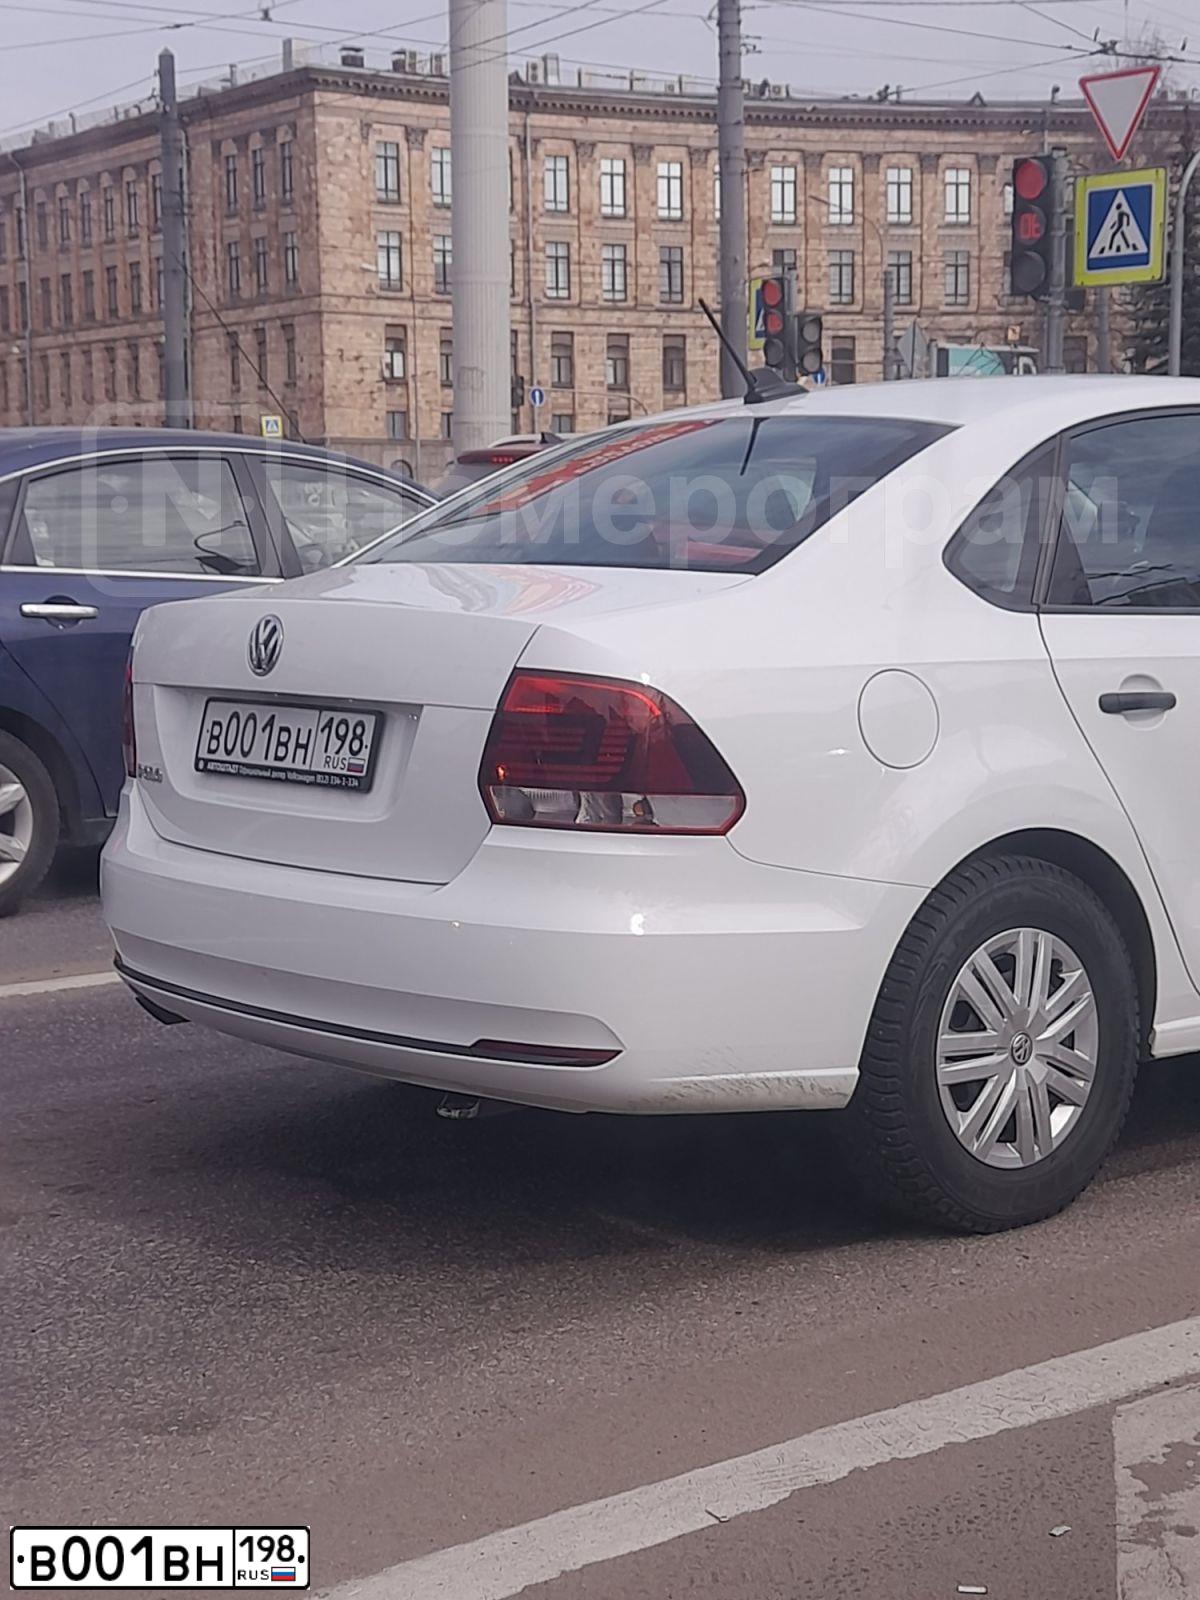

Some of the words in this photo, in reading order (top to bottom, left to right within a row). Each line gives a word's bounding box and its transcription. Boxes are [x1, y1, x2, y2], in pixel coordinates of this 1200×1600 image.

[208, 711, 312, 765] В001ВН
[321, 716, 366, 757] 198
[324, 755, 347, 770] RUS
